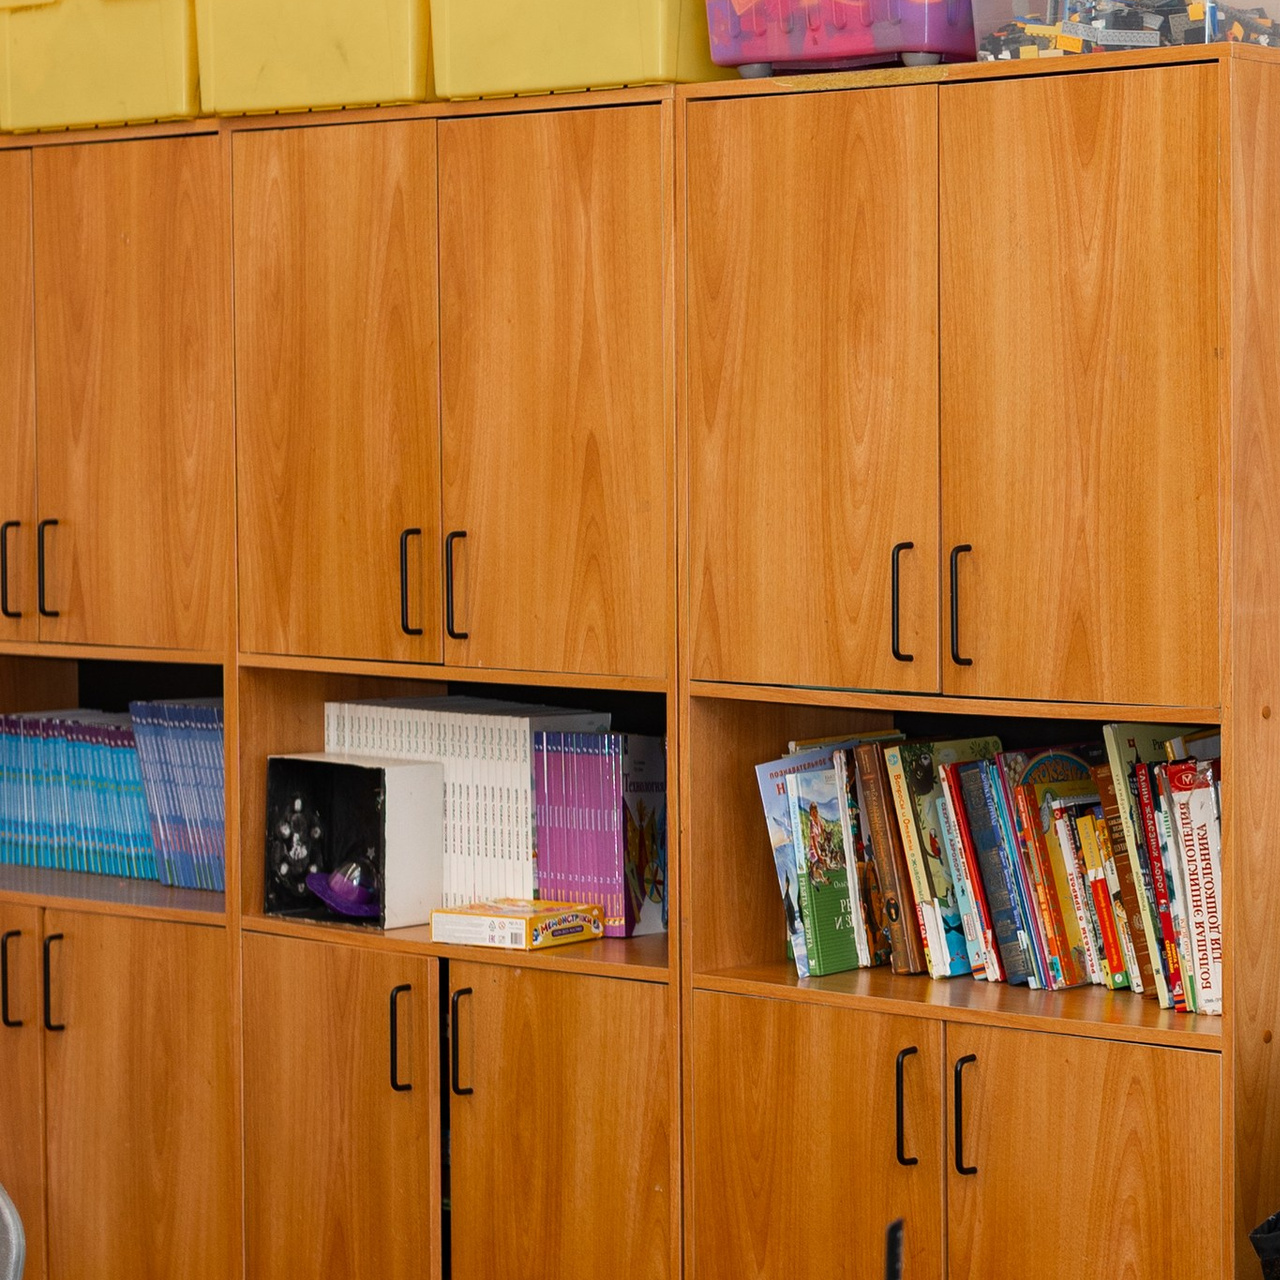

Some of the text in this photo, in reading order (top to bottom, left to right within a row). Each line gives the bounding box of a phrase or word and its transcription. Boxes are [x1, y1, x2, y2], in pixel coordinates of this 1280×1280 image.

[893, 773, 905, 811] Вопросы
[903, 817, 914, 851] Ответы
[1180, 802, 1212, 990] БОЛЬШАЯ ЭНЦИКЛОПЕДИЯ
[1196, 823, 1219, 928] ДОШКОЛЬНИКА
